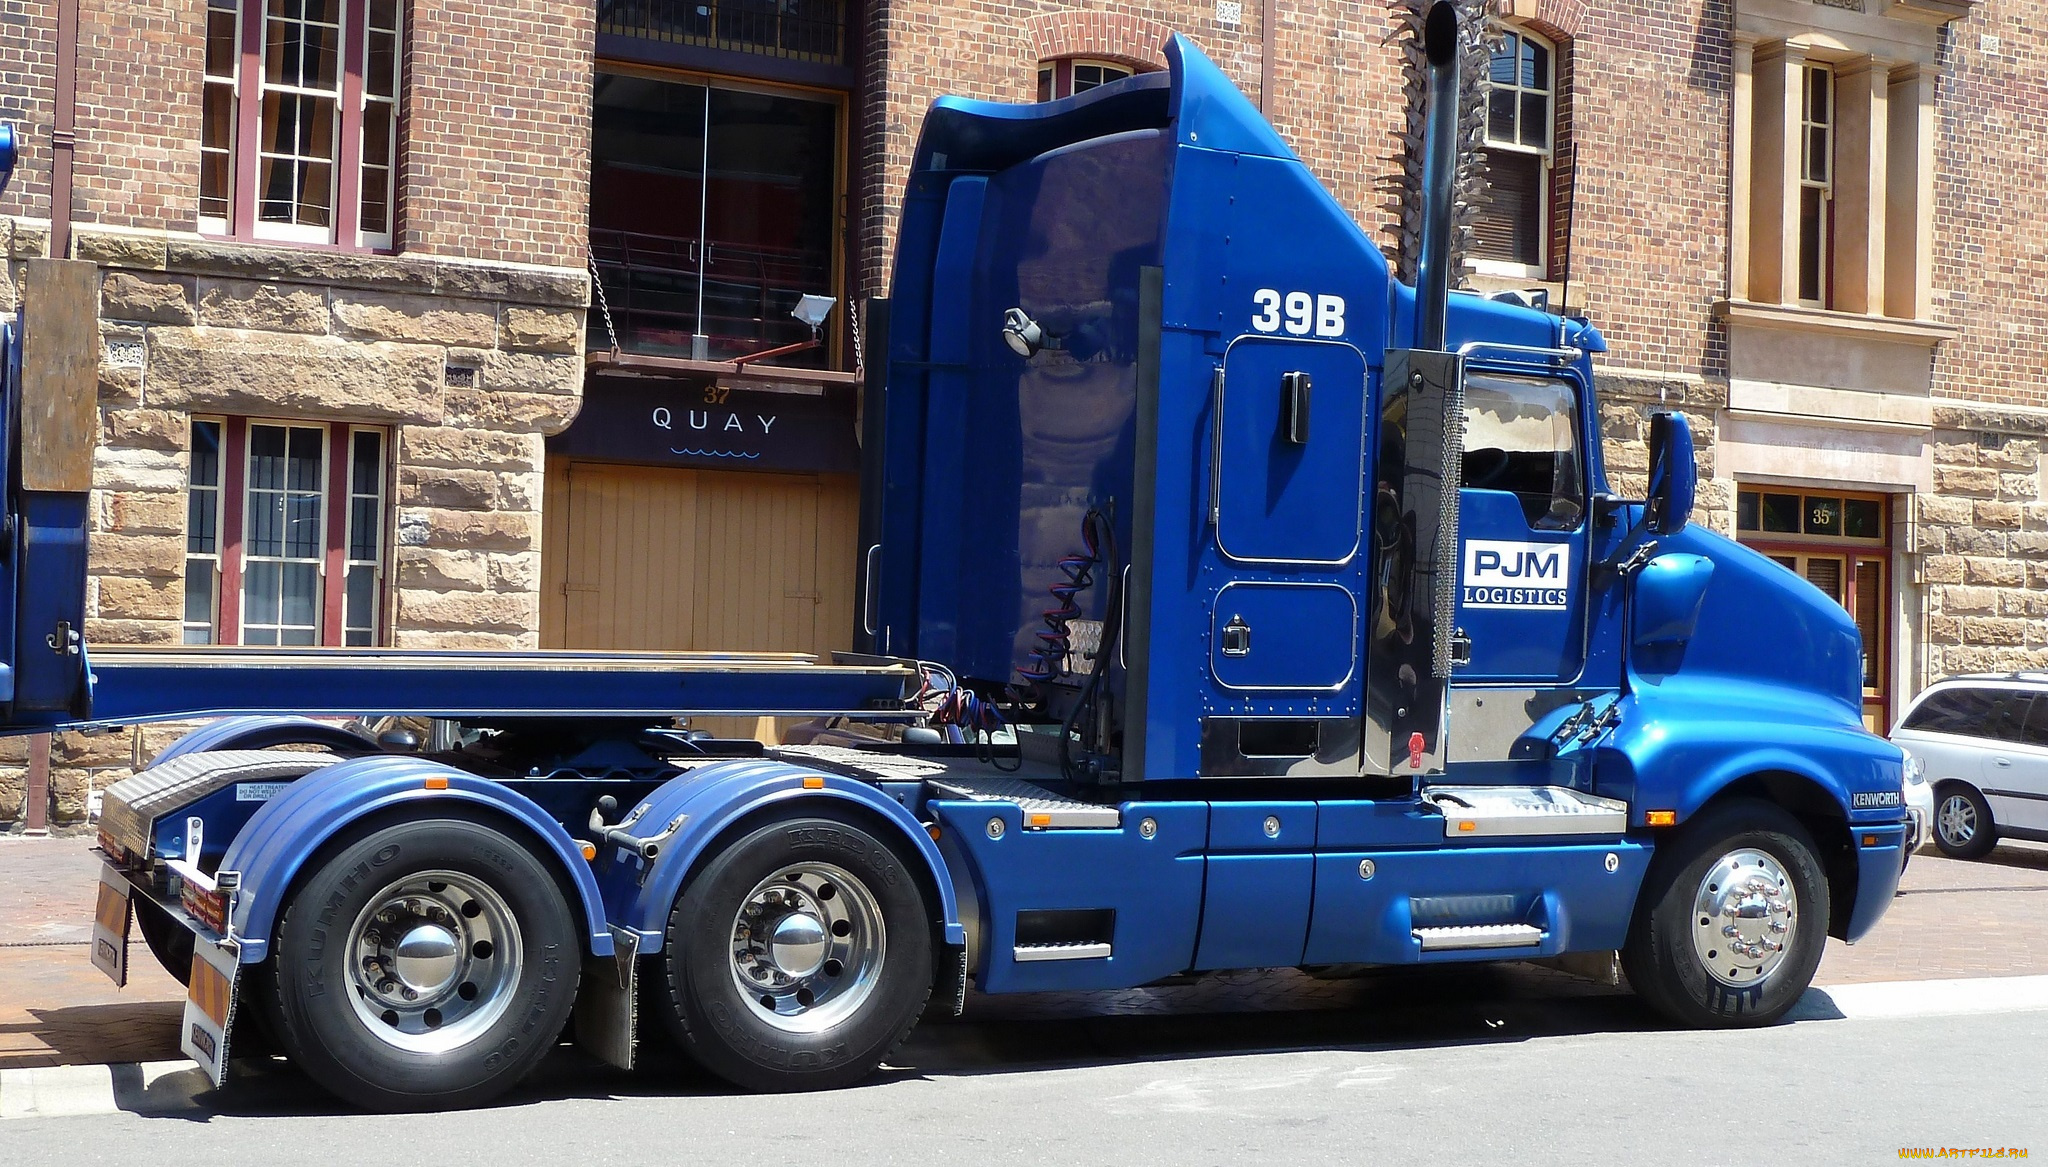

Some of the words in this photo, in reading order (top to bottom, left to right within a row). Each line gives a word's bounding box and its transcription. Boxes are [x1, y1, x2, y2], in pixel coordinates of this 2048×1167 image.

[1252, 288, 1345, 337] 39B
[704, 384, 730, 404] 37
[652, 407, 777, 434] QUAY
[1812, 508, 1830, 525] 35
[1474, 550, 1559, 579] PJM
[1463, 587, 1567, 605] LOGISTICS
[1852, 792, 1900, 807] KENWORTH
